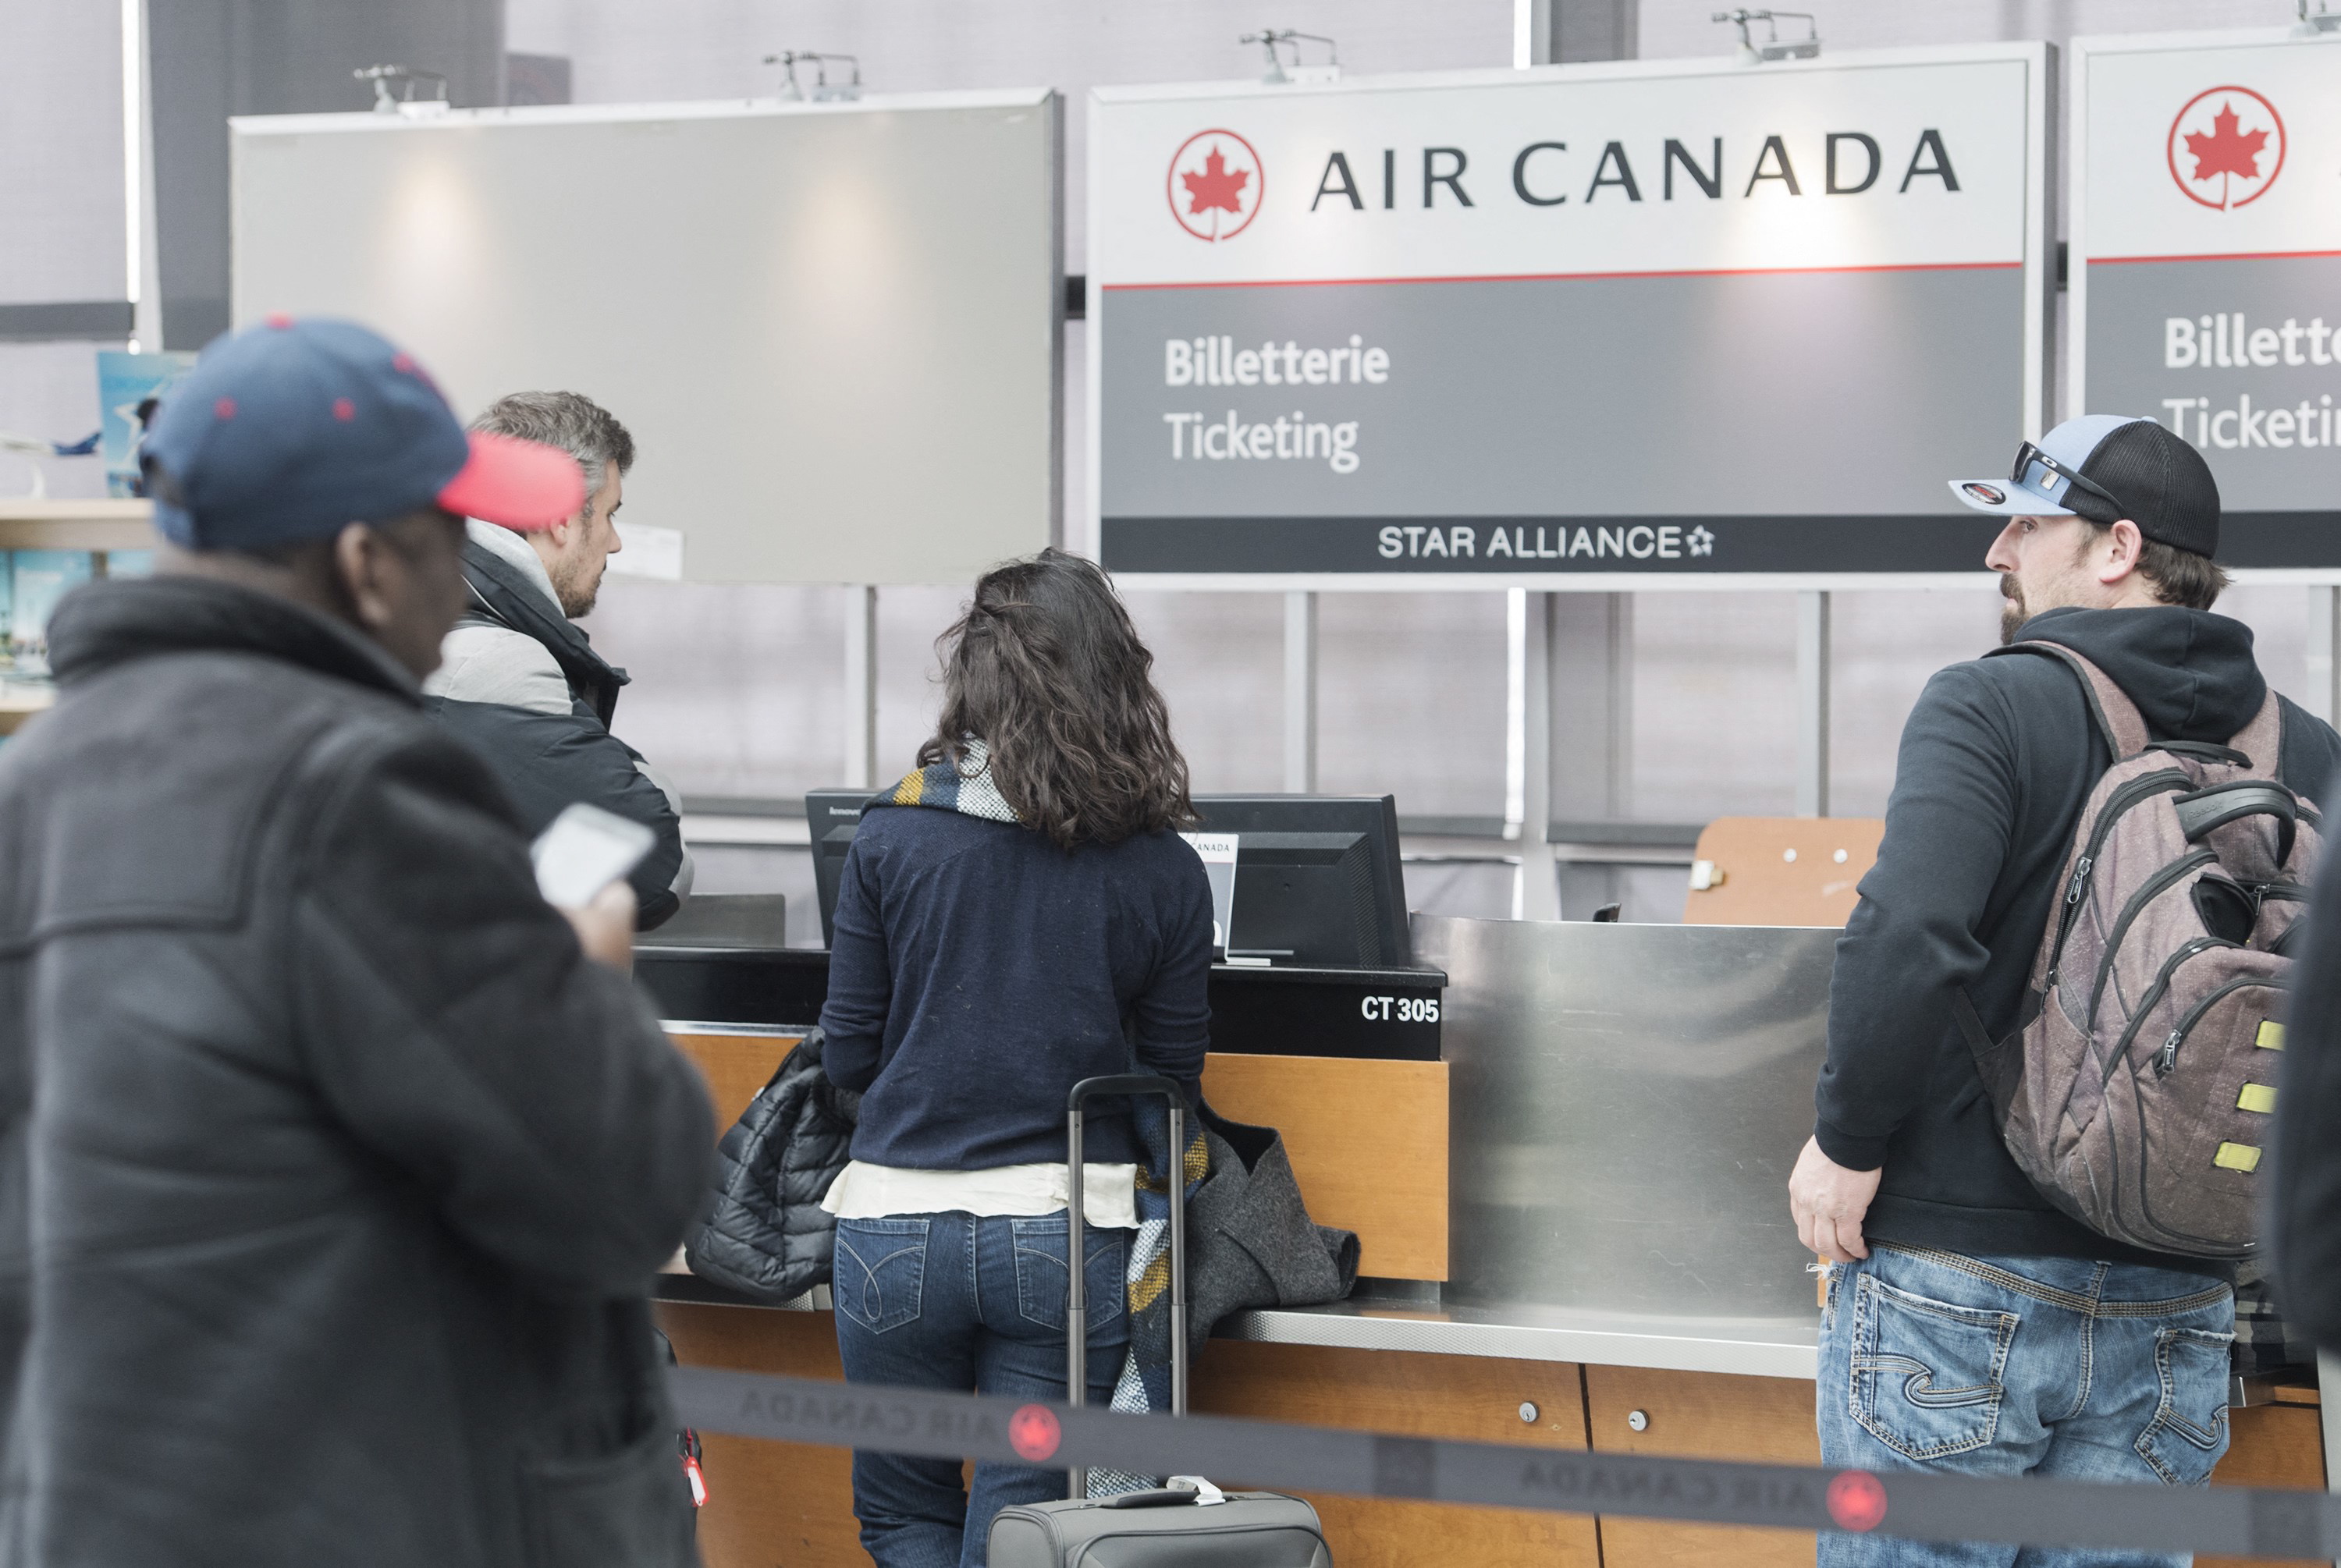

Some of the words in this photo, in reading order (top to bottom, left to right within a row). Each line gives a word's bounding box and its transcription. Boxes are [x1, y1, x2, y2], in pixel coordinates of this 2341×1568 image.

[1311, 147, 1474, 211] AIR
[1512, 129, 1961, 207] CANADA
[1165, 334, 1390, 386] Billetterie
[1163, 409, 1360, 474] Ticketing
[2162, 392, 2341, 449] Ticketi
[1378, 526, 1476, 559] STAR
[1486, 525, 1682, 559] ALLIANCE
[1361, 995, 1394, 1020] CT
[1397, 998, 1440, 1023] 305
